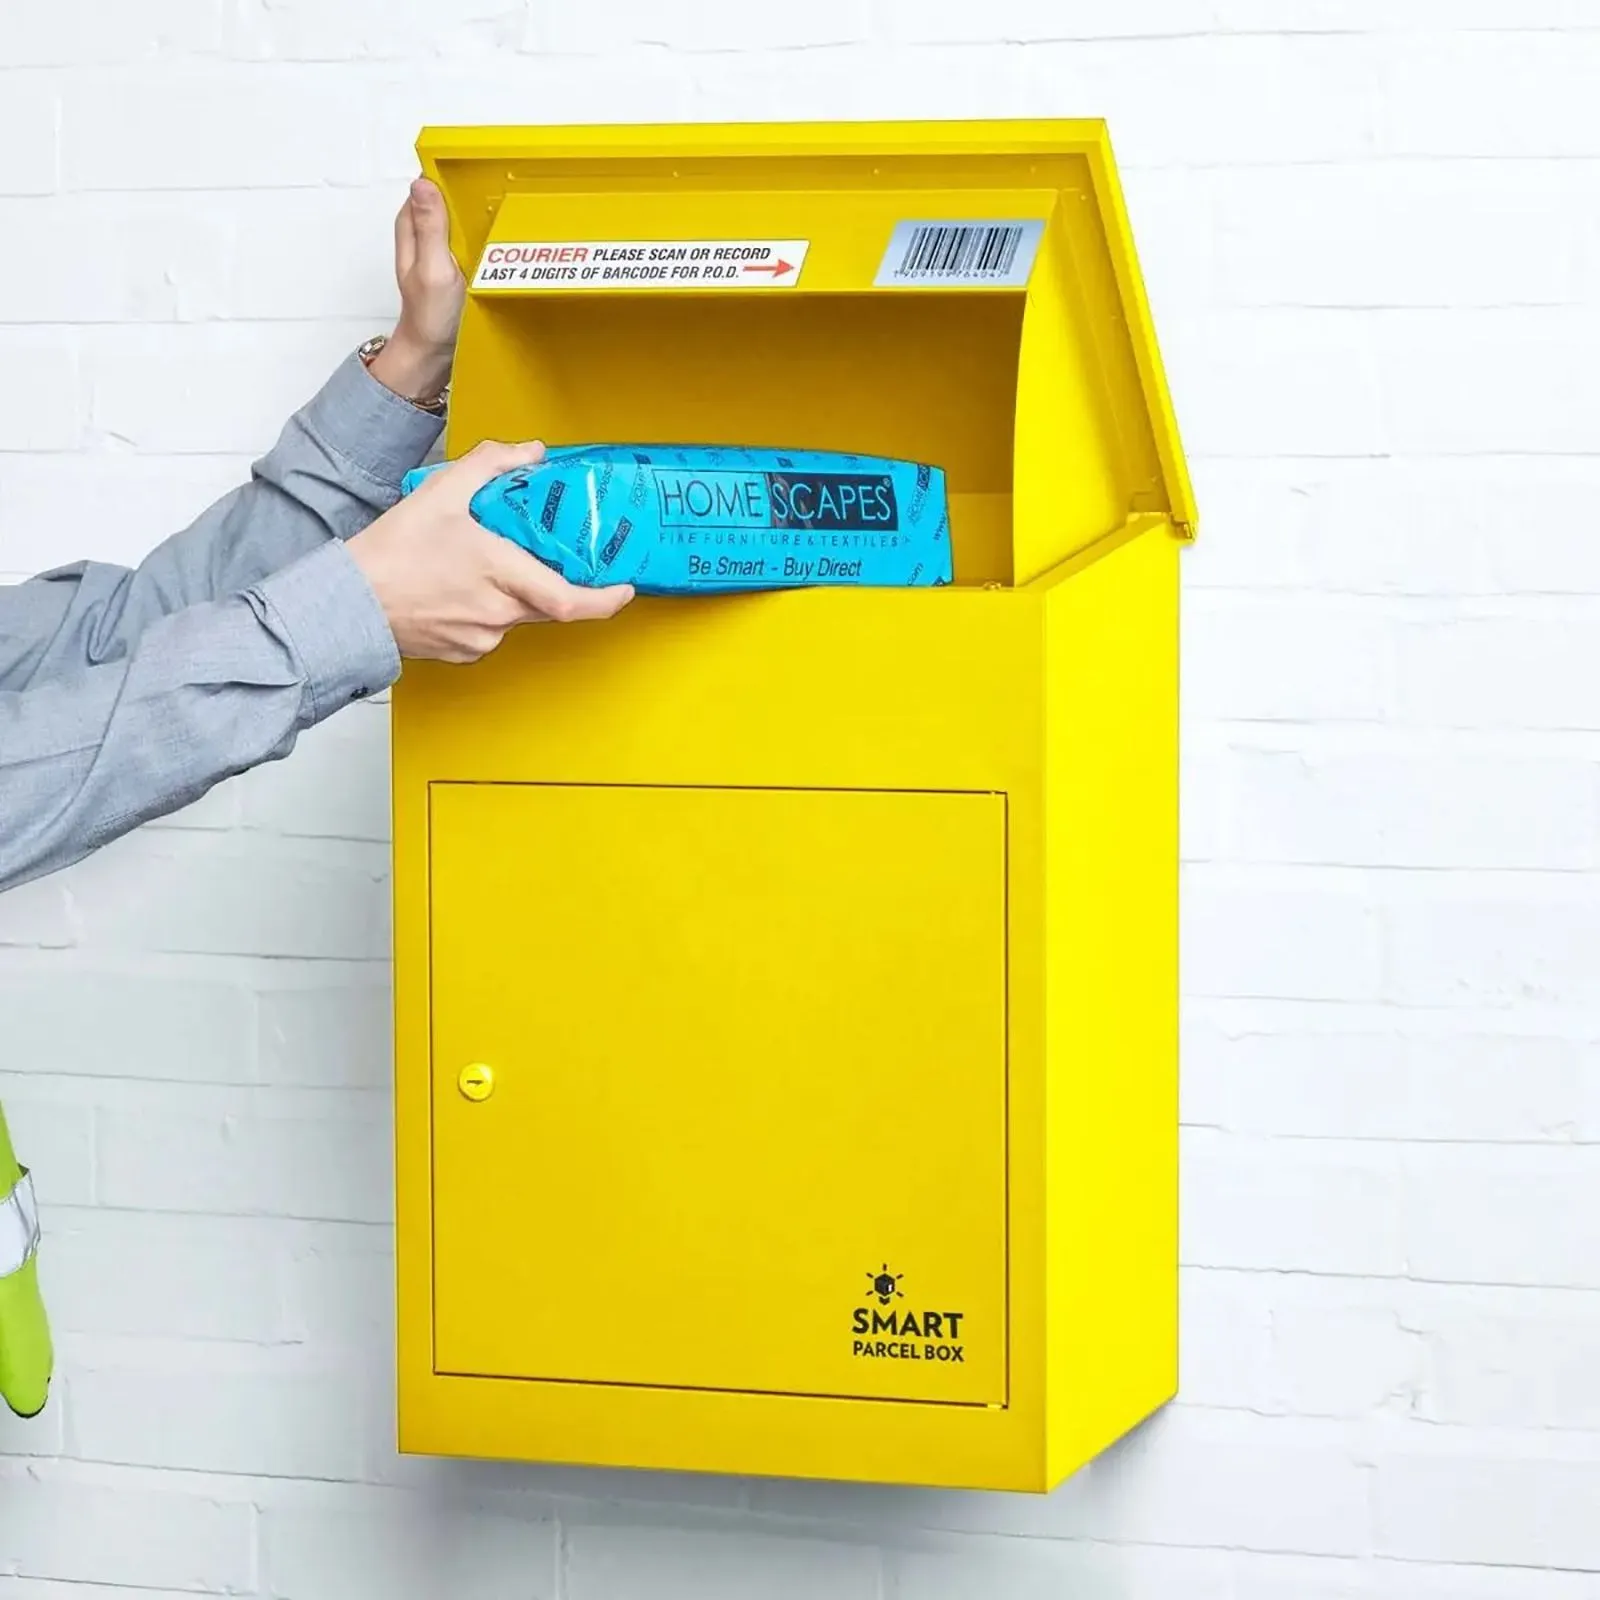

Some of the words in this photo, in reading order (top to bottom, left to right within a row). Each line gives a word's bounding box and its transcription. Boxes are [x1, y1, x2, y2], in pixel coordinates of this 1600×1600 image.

[488, 247, 589, 264] COURIER
[593, 248, 646, 261] PLEASE
[648, 248, 687, 261] SCAN
[690, 247, 710, 261] OR
[713, 247, 771, 260] RECORD
[481, 267, 517, 280] LAST
[519, 268, 528, 280] 4
[531, 267, 578, 280] DIGITS
[581, 266, 600, 280] OF
[602, 266, 668, 280] BARCODE
[671, 265, 699, 279] FOR
[702, 265, 739, 279] P.O.D.
[660, 480, 763, 517] HOME
[772, 483, 891, 521] SCAPES
[704, 533, 801, 546] FURNITURE
[821, 535, 899, 548] TEXTILES
[689, 555, 711, 575] Be
[716, 556, 765, 576] Smart
[784, 557, 814, 581] Buy
[817, 557, 861, 577] Direct
[852, 1307, 963, 1339] SMART
[853, 1341, 921, 1360] PARCEL
[924, 1344, 965, 1362] BOX
